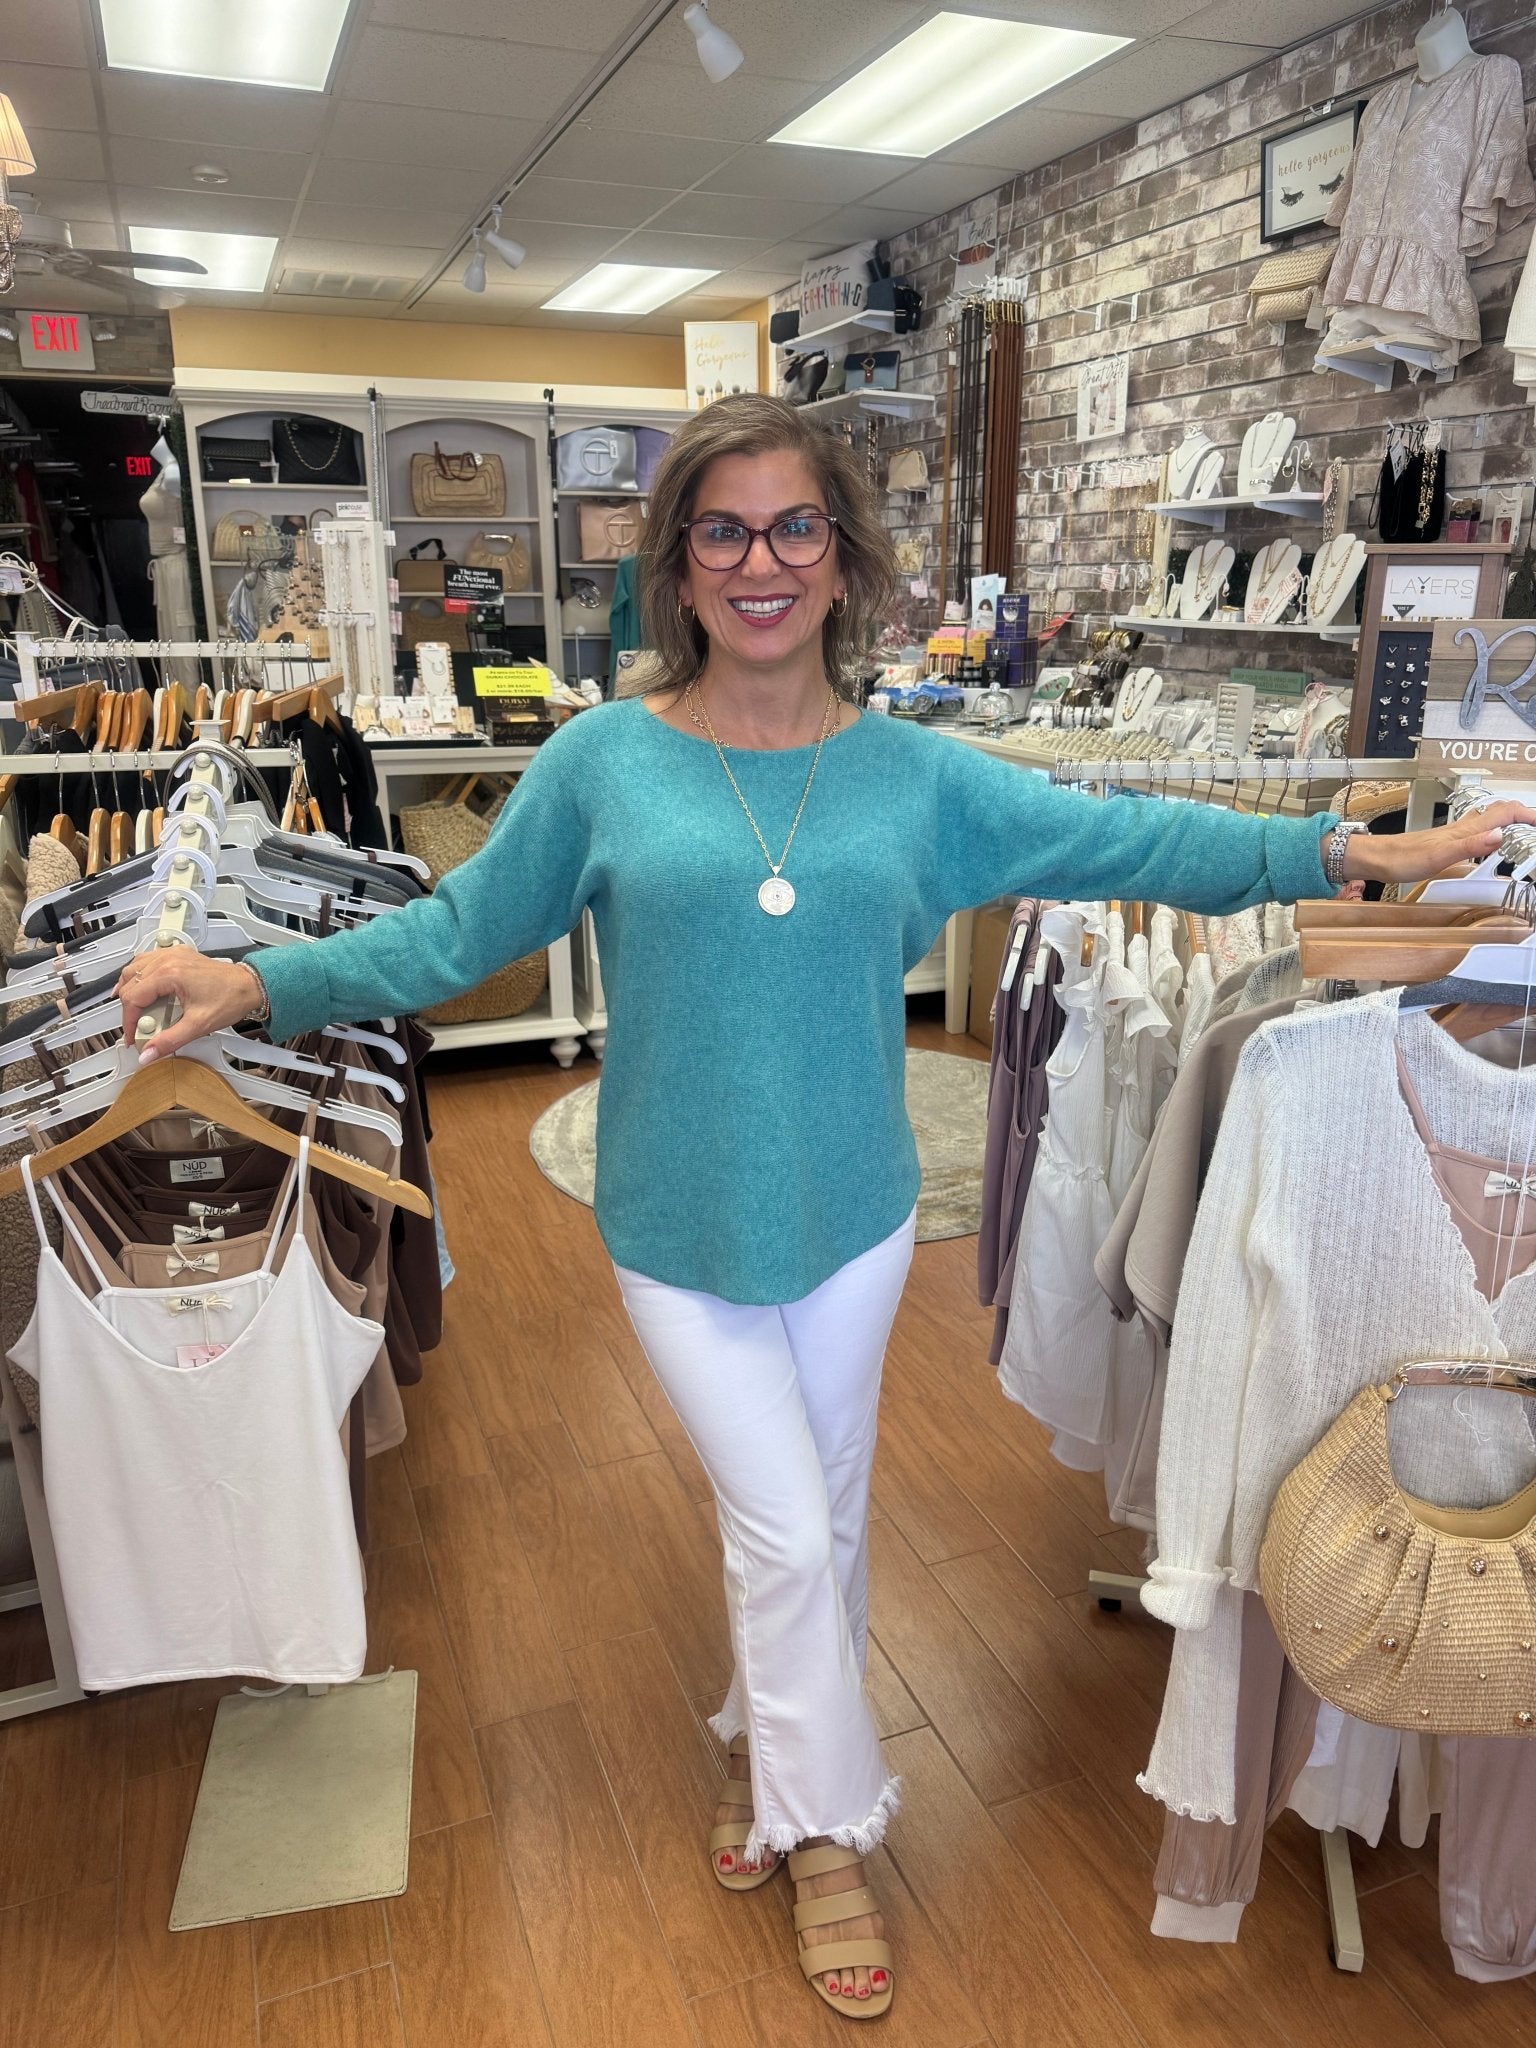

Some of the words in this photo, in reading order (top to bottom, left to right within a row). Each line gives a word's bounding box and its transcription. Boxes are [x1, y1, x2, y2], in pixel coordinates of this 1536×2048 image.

[1278, 160, 1303, 176] hello
[1308, 144, 1351, 172] gorgeous
[803, 264, 850, 287] happy
[30, 315, 79, 352] EXIT
[84, 392, 140, 412] Treatment
[140, 396, 172, 414] Room
[126, 456, 152, 476] EXIT
[447, 580, 469, 588] breath
[453, 574, 496, 584] FUNctional
[1390, 576, 1475, 595] LAYERS
[1439, 741, 1519, 761] YOU'RE
